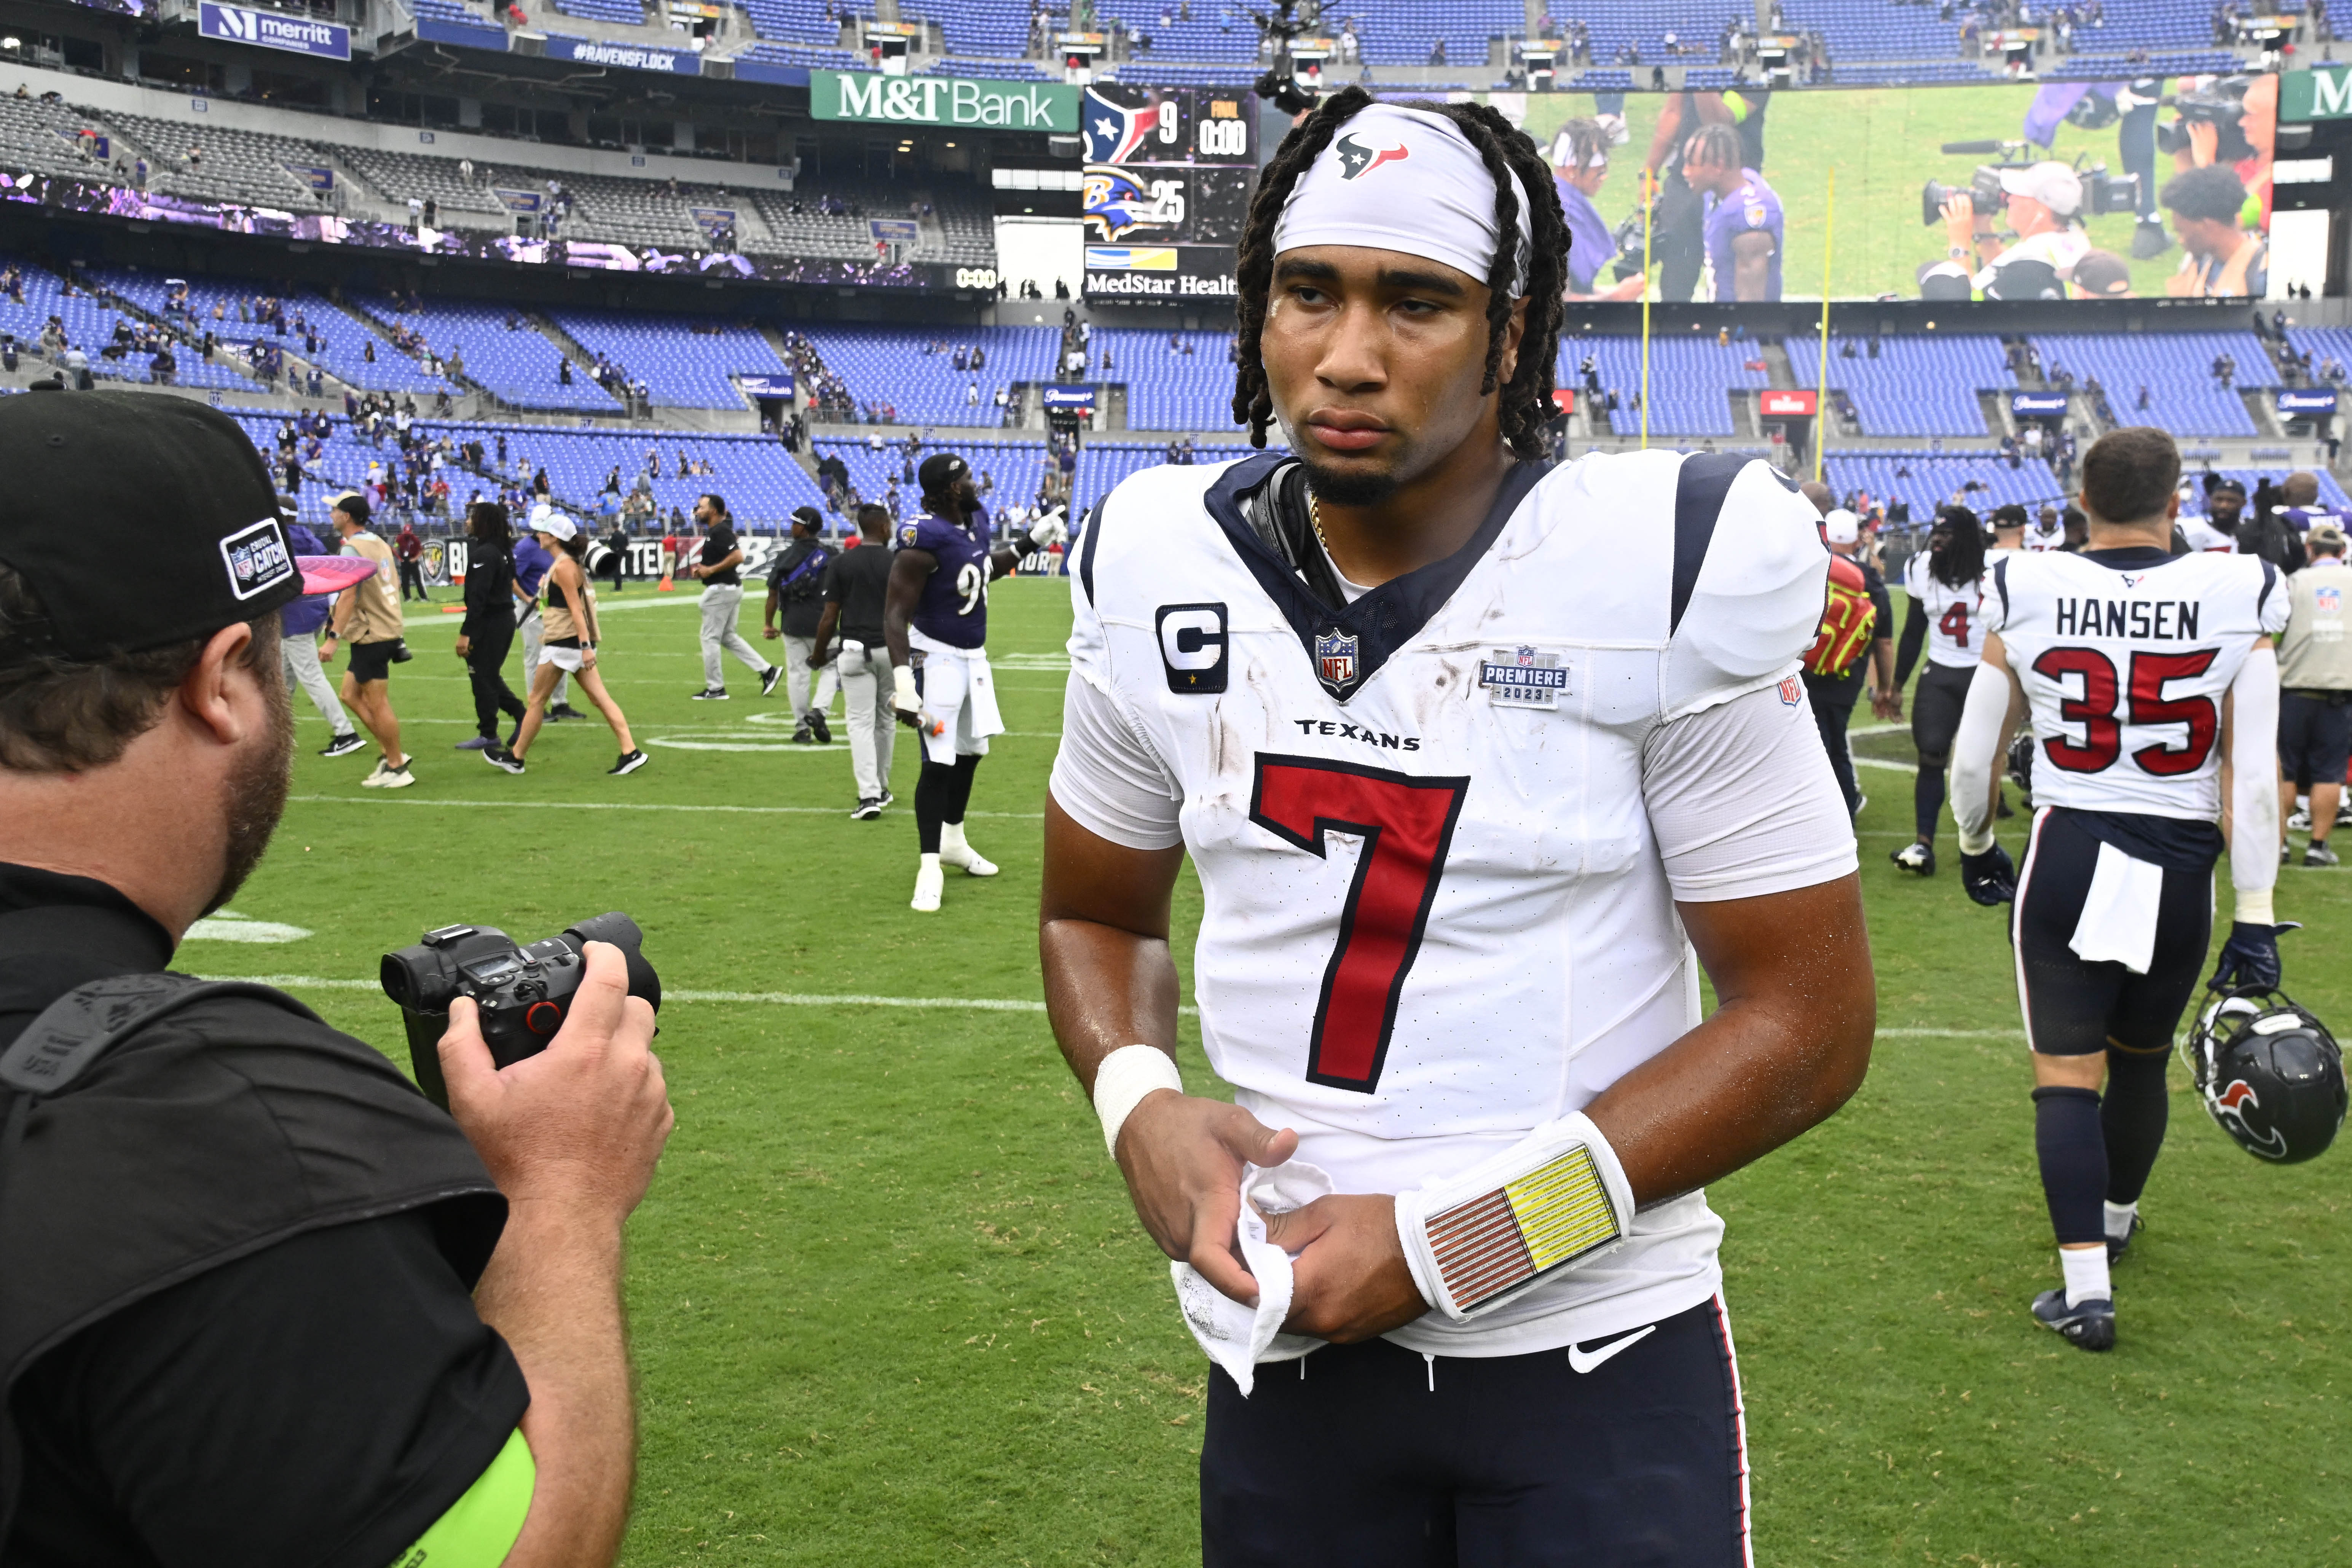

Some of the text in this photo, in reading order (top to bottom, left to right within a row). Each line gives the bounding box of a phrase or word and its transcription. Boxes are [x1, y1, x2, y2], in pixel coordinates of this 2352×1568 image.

[261, 18, 332, 45] merritt
[573, 43, 675, 71] #RAVENSFLOCK
[837, 75, 1054, 127] M&T Bank
[1159, 101, 1177, 143] 9
[1151, 180, 1185, 223] 25
[957, 268, 996, 289] 0:00
[1087, 272, 1239, 295] MedStar Healt
[237, 560, 254, 576] NFL
[254, 541, 286, 573] CATCH
[1939, 602, 1971, 647] 4
[2057, 598, 2199, 640] HANSEN
[1161, 610, 1221, 670] C
[1322, 658, 1352, 682] NFL
[1519, 655, 1532, 665] NFL
[1504, 687, 1542, 700] 2023
[1778, 677, 1800, 702] NFL
[2032, 647, 2221, 777] 35
[1294, 719, 1420, 752] TEXANS
[1249, 751, 1471, 1095] 7
